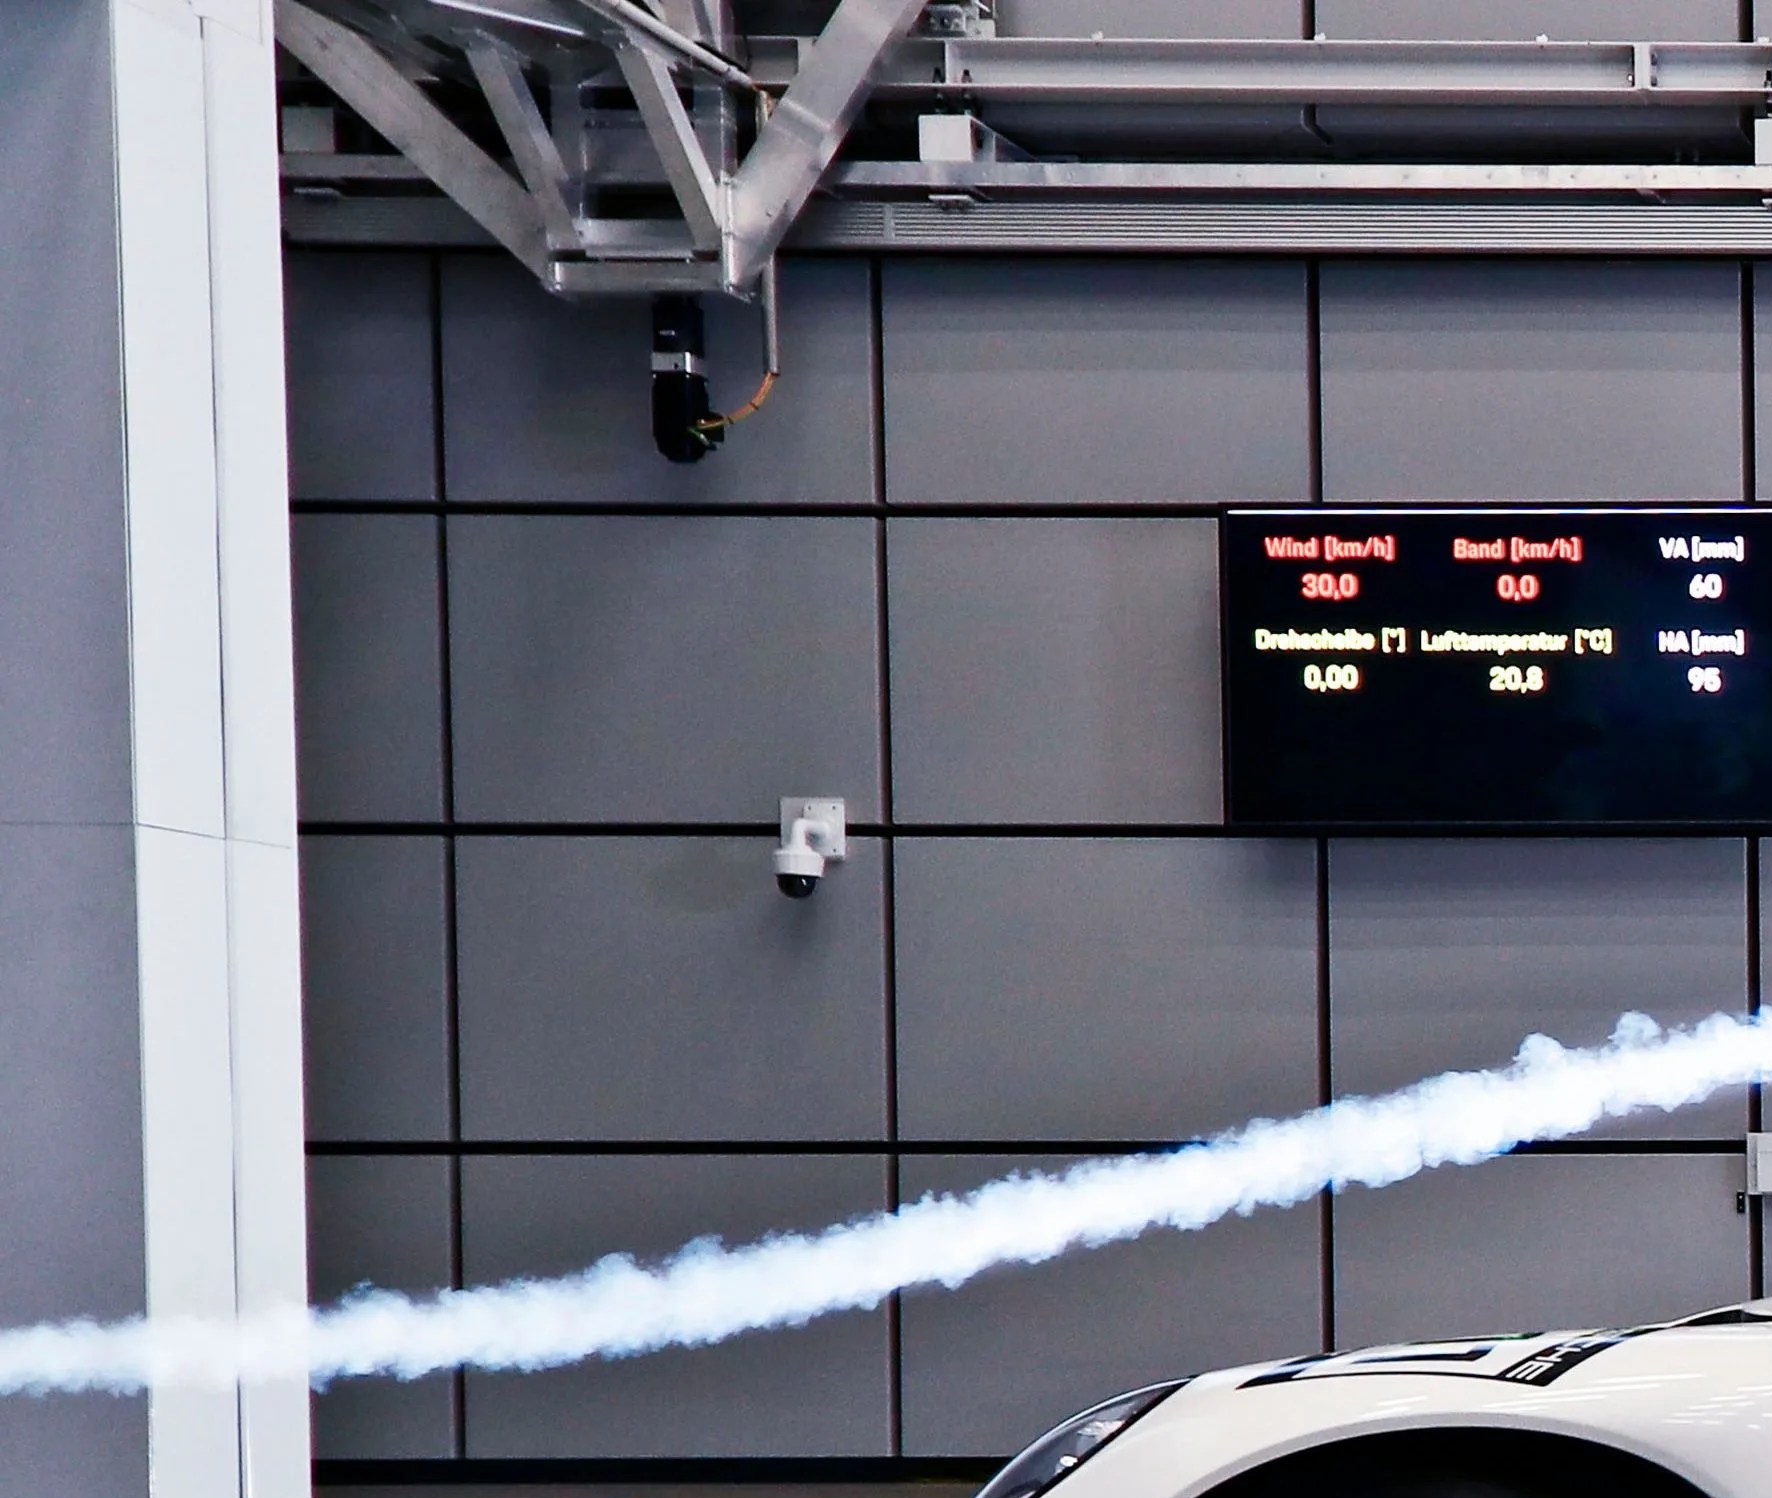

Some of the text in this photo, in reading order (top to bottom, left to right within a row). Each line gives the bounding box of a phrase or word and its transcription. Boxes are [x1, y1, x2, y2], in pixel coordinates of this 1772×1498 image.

[1264, 535, 1395, 562] Wind [km/h]
[1453, 536, 1582, 563] Band [km/h]
[1659, 536, 1744, 562] VA [mm]
[1302, 573, 1359, 600] 30,0
[1497, 574, 1539, 602] 0,0
[1689, 573, 1723, 599] 60
[1657, 629, 1745, 656] HA [mm]
[1304, 664, 1360, 692] 0,00
[1490, 666, 1544, 693] 20,8
[1688, 667, 1721, 693] 95
